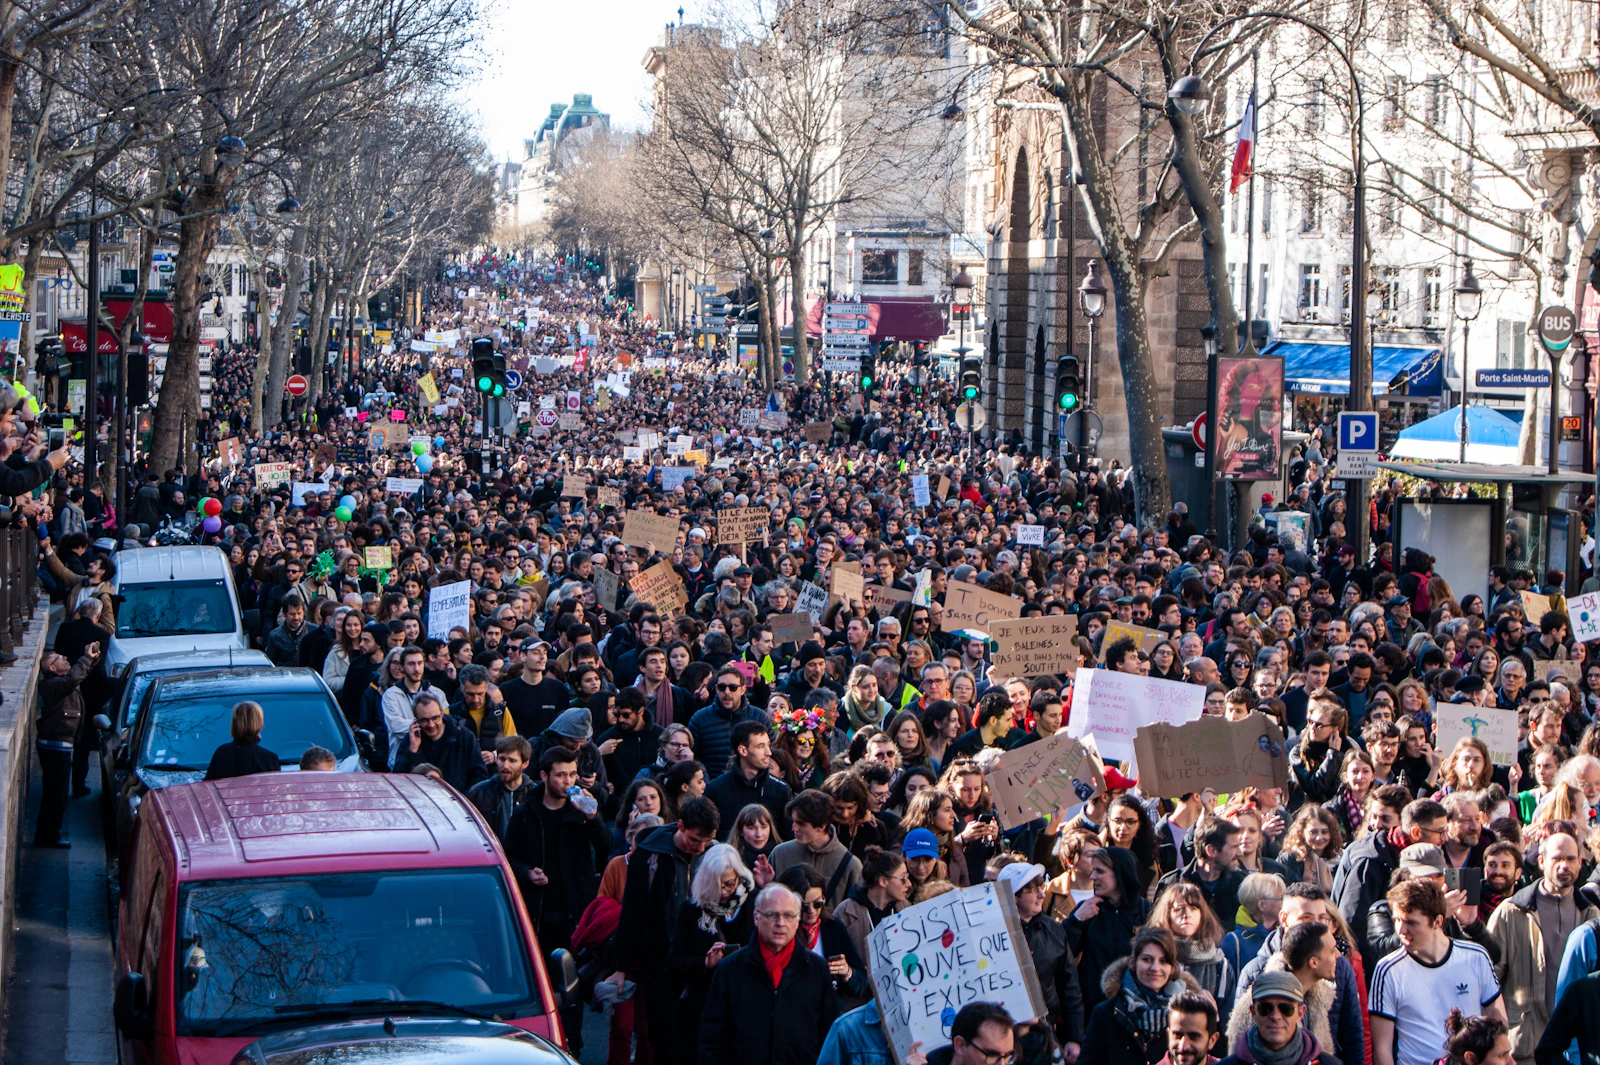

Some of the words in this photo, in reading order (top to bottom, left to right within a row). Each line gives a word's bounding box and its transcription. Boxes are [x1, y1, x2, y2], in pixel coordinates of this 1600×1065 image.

[933, 293, 953, 303] KF
[1544, 316, 1571, 331] BUS
[99, 341, 112, 350] de
[1480, 373, 1500, 383] Porte
[1502, 373, 1549, 383] Saint-Martin
[539, 414, 556, 424] STOP
[1565, 418, 1578, 428] 20
[1350, 420, 1367, 444] P
[1224, 434, 1240, 459] Yes
[258, 473, 264, 481] DE
[630, 512, 679, 528] TRANSITION
[629, 523, 673, 537] ECOLOGIQUE
[722, 525, 734, 533] ON
[627, 532, 670, 547] SOLIDAIRE
[634, 572, 669, 596] MILLIARDS
[653, 579, 672, 594] SAUVER
[431, 593, 469, 613] TEMPERATURE
[956, 588, 972, 604] T
[979, 597, 1014, 617] bonne
[998, 627, 1013, 637] JE
[1019, 624, 1045, 635] VEUX
[1051, 624, 1068, 633] DES
[995, 652, 1012, 665] PAS
[1016, 653, 1029, 661] QUE
[1034, 652, 1053, 661] DANS
[1055, 651, 1073, 660] MON
[1081, 678, 1122, 690] ENVOYEZ
[1143, 683, 1194, 708] SAUVEZ
[1156, 703, 1175, 717] LA
[1104, 713, 1121, 722] TOUS
[1091, 725, 1130, 736] FINANCIERS
[1153, 732, 1171, 743] TA
[1482, 727, 1506, 736] avait
[1157, 748, 1174, 758] TU
[1013, 750, 1045, 785] PARCE
[1046, 736, 1062, 751] QUE
[1041, 756, 1062, 779] NOTRE
[1184, 758, 1201, 766] OU
[1178, 768, 1193, 779] TE
[979, 931, 1009, 960] QUE
[890, 1001, 911, 1030] TU
